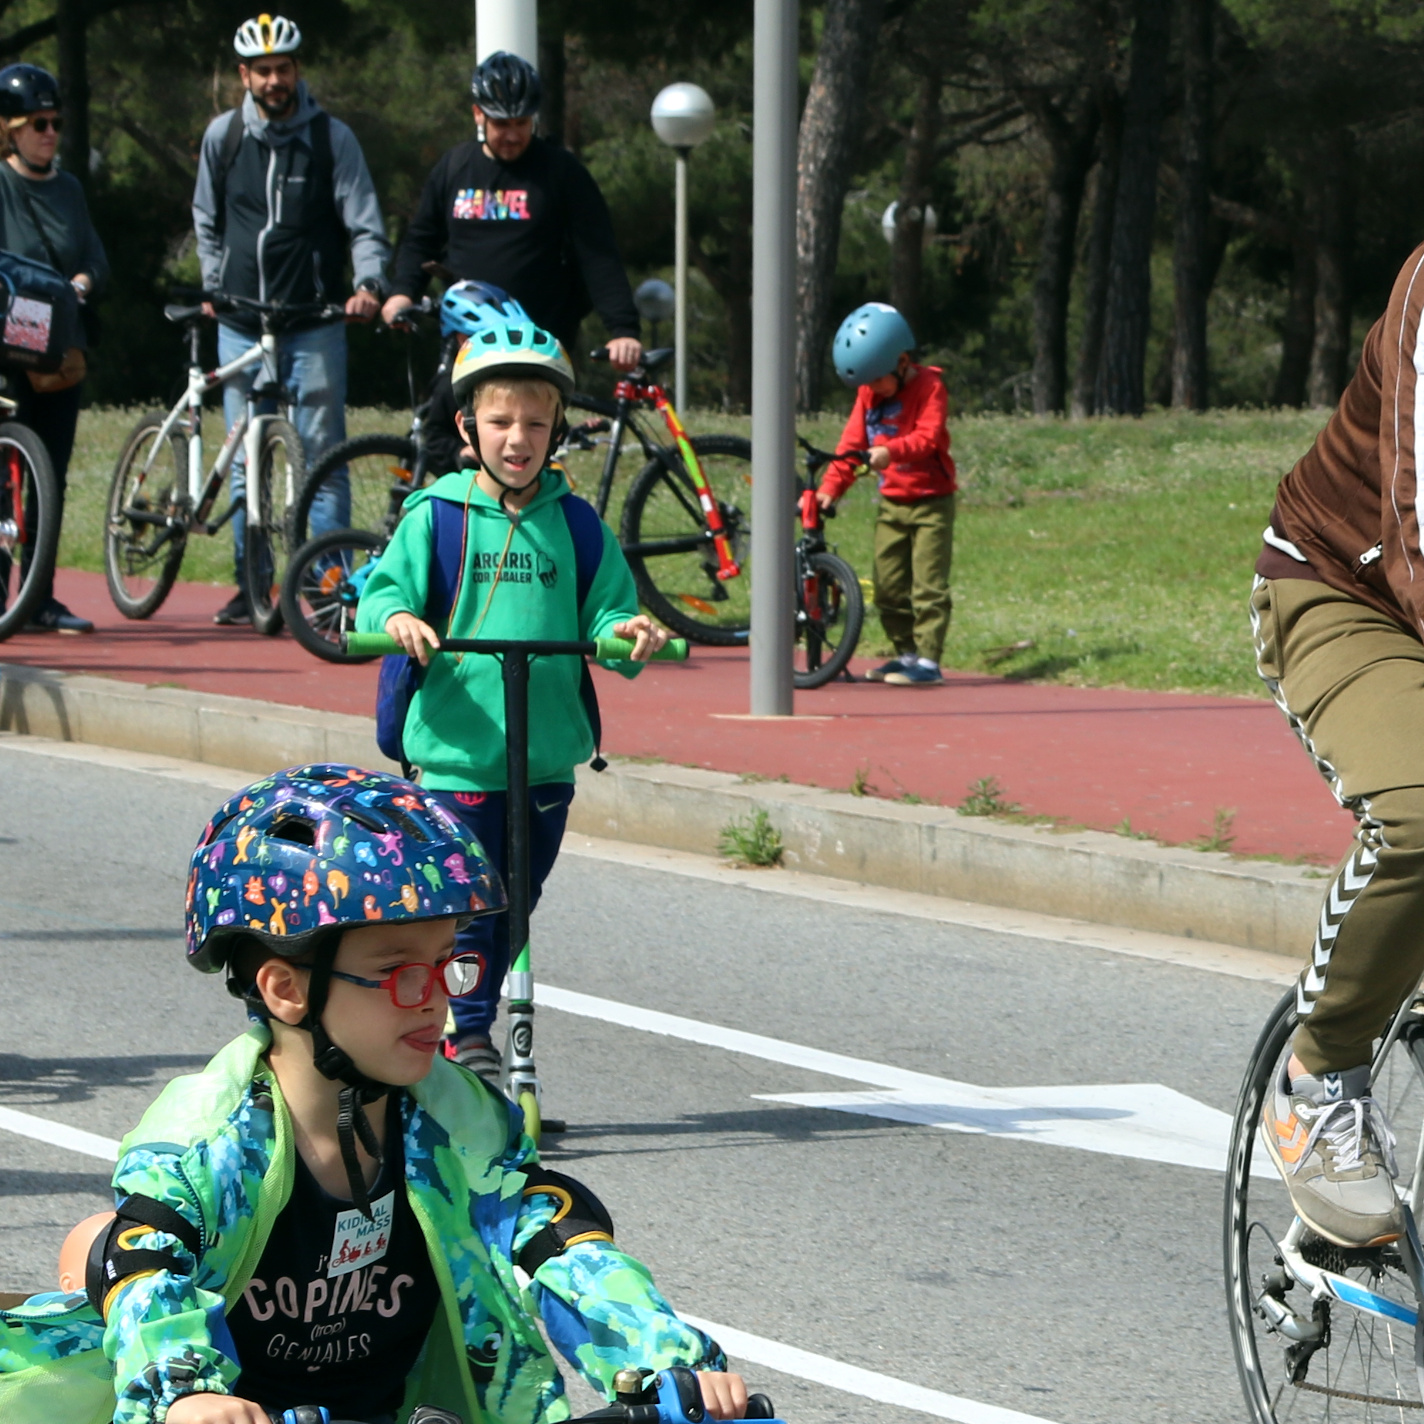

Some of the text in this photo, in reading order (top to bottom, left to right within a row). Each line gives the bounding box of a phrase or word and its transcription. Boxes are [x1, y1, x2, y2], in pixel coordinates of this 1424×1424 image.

[453, 188, 531, 220] MARVEL
[473, 552, 532, 569] ARCIRIS
[356, 1215, 391, 1239] MASS
[243, 1265, 415, 1323] COPINES
